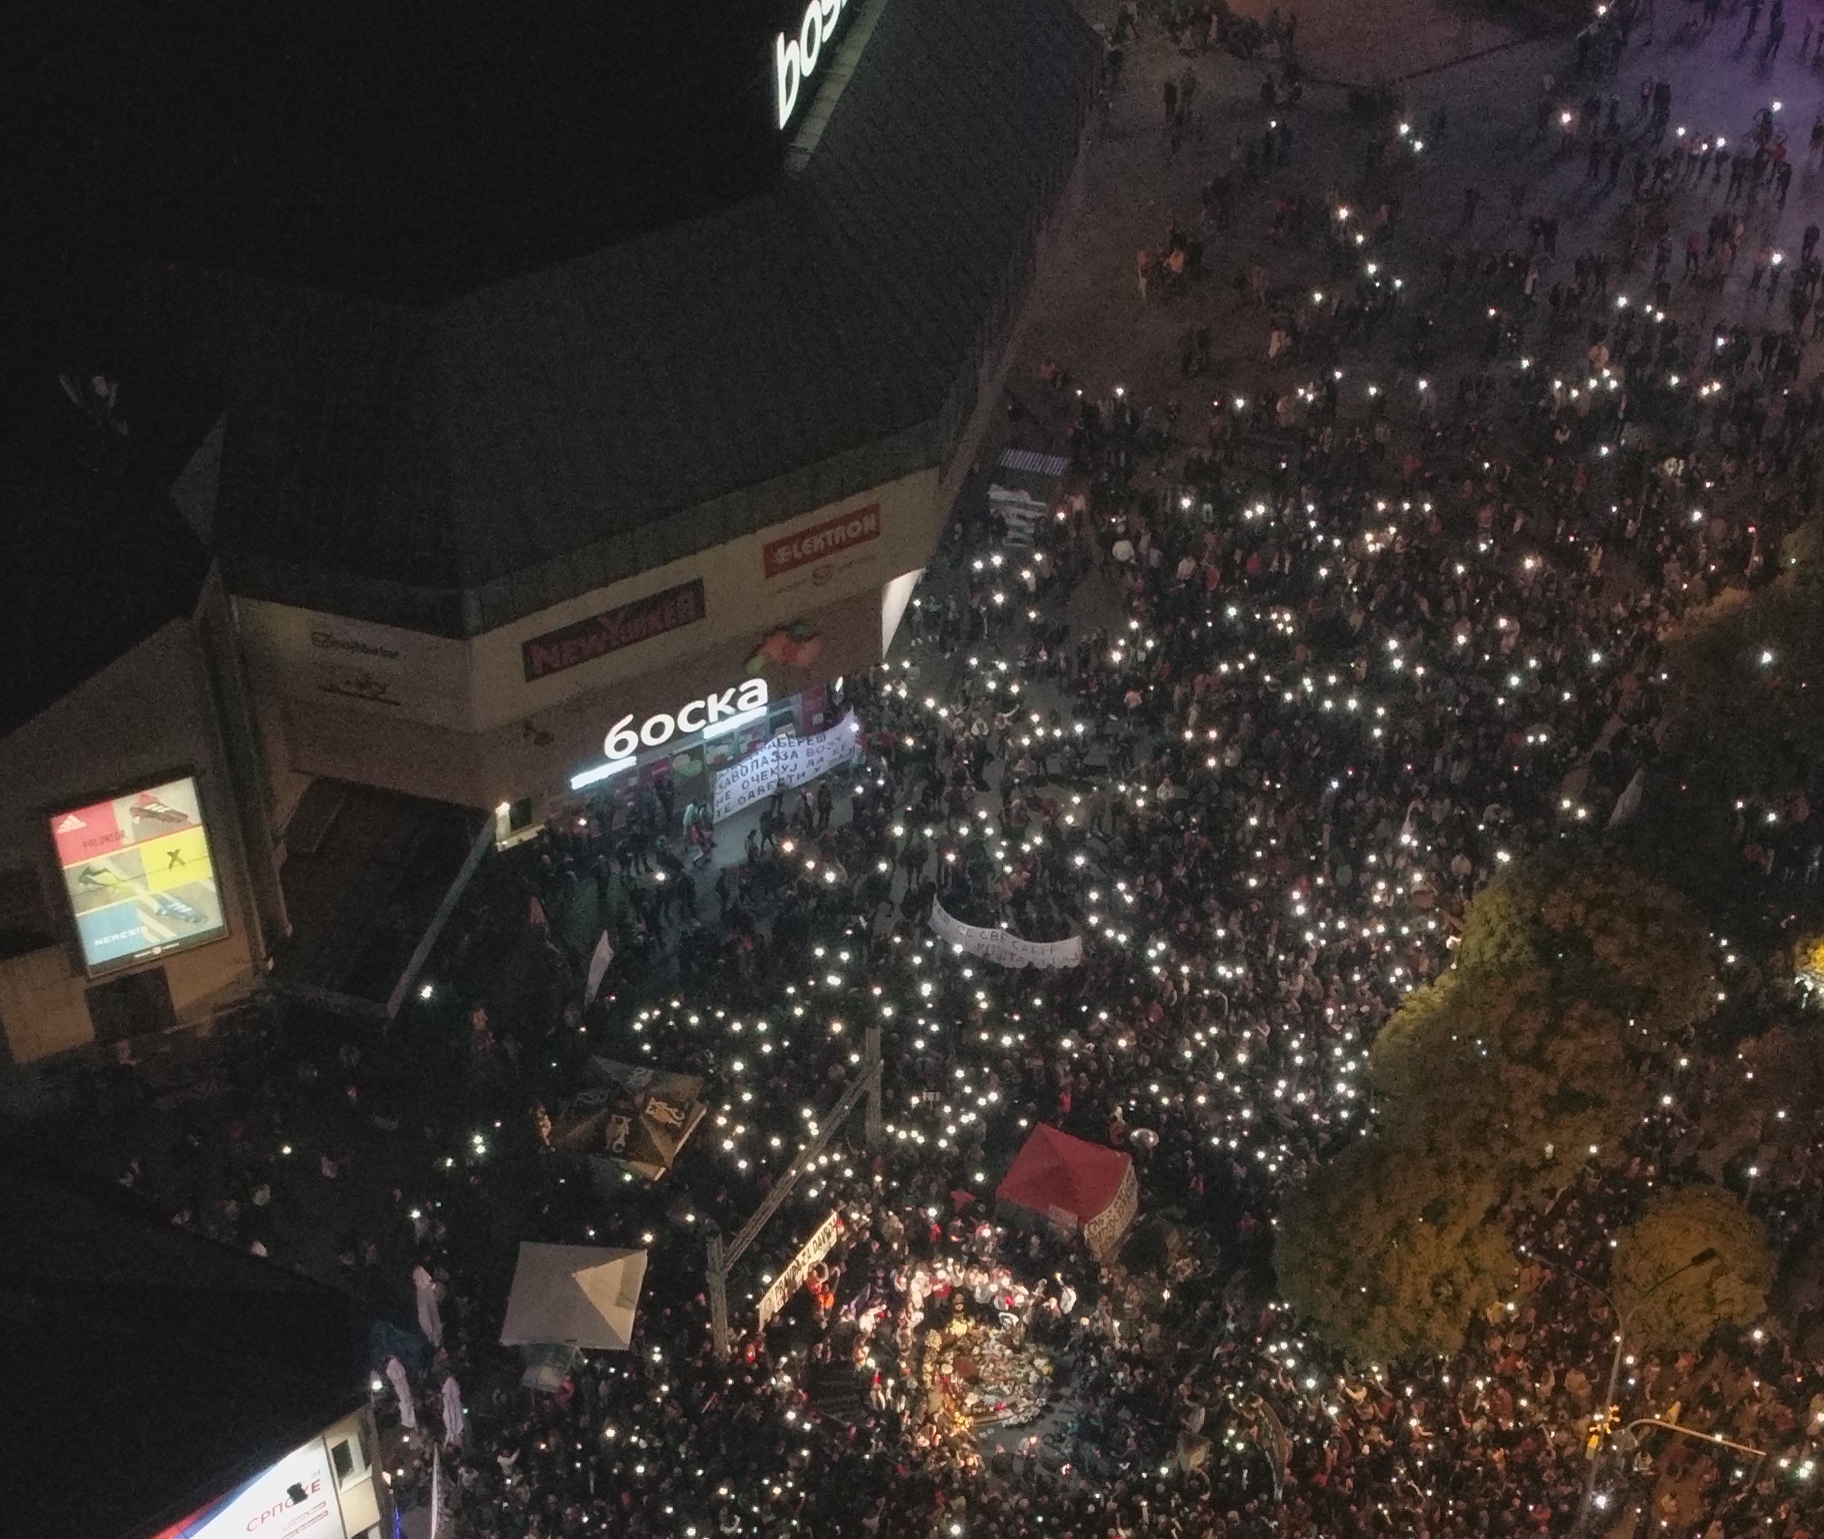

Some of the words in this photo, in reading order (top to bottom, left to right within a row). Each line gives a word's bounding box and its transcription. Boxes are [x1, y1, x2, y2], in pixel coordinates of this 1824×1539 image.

[776, 0, 847, 130] bos
[773, 512, 876, 565] ELEKTRON
[604, 677, 768, 760] боска
[166, 848, 186, 871] X
